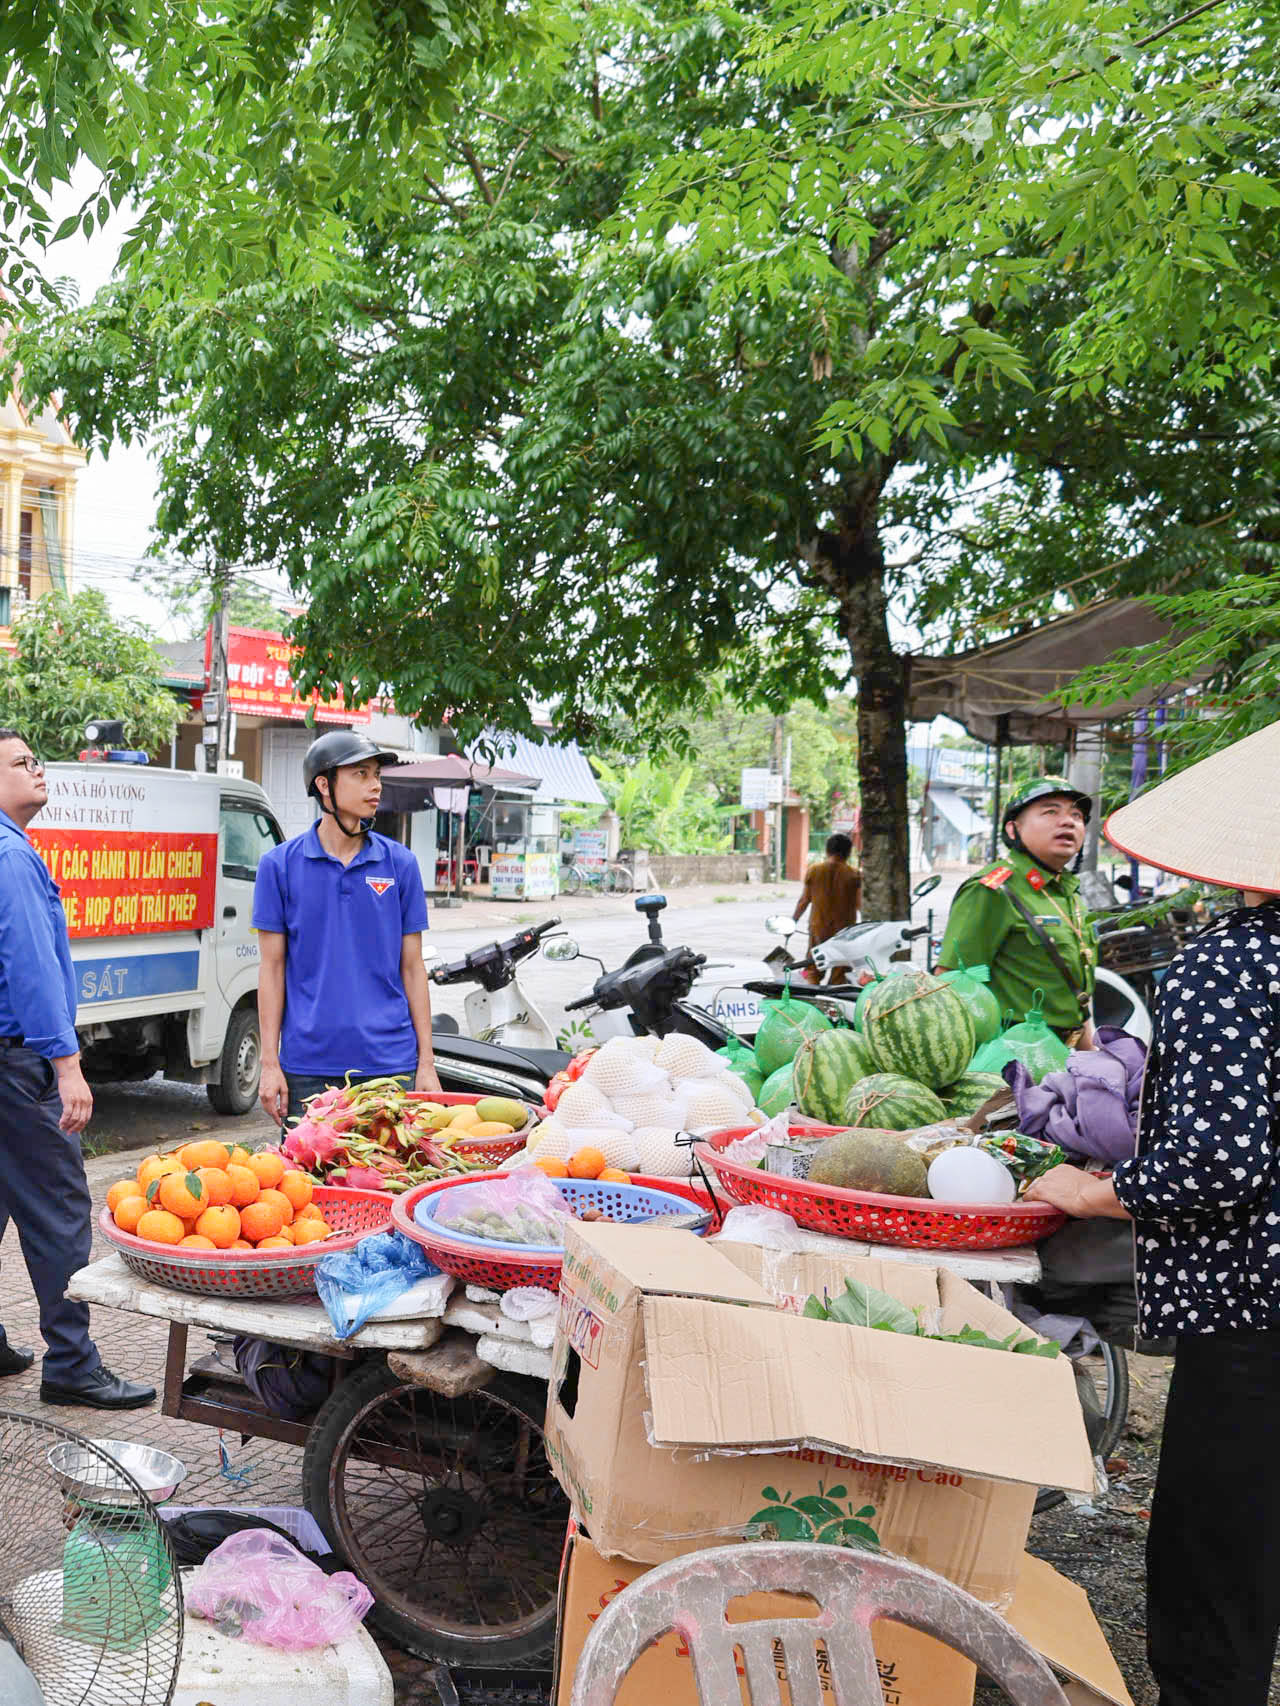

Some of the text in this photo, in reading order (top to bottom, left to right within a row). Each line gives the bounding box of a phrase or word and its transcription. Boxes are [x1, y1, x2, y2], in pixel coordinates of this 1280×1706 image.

[241, 662, 264, 688] BỘT
[54, 781, 69, 796] AN
[73, 779, 87, 797] XÃ
[110, 784, 145, 801] VƯƠNG
[65, 804, 86, 822] SÁT
[62, 843, 88, 880] CÁC
[91, 843, 126, 880] HÀNH
[128, 851, 140, 879] VI
[142, 841, 165, 879] LẤN
[167, 842, 202, 878] CHIẾM
[85, 896, 111, 933] HỌP
[114, 892, 139, 930] CHỢ
[141, 888, 166, 923] TRÁI
[168, 888, 196, 921] PHÉP
[236, 944, 258, 958] CÔNG
[82, 965, 129, 998] SÁT
[917, 1470, 963, 1488] Cao
